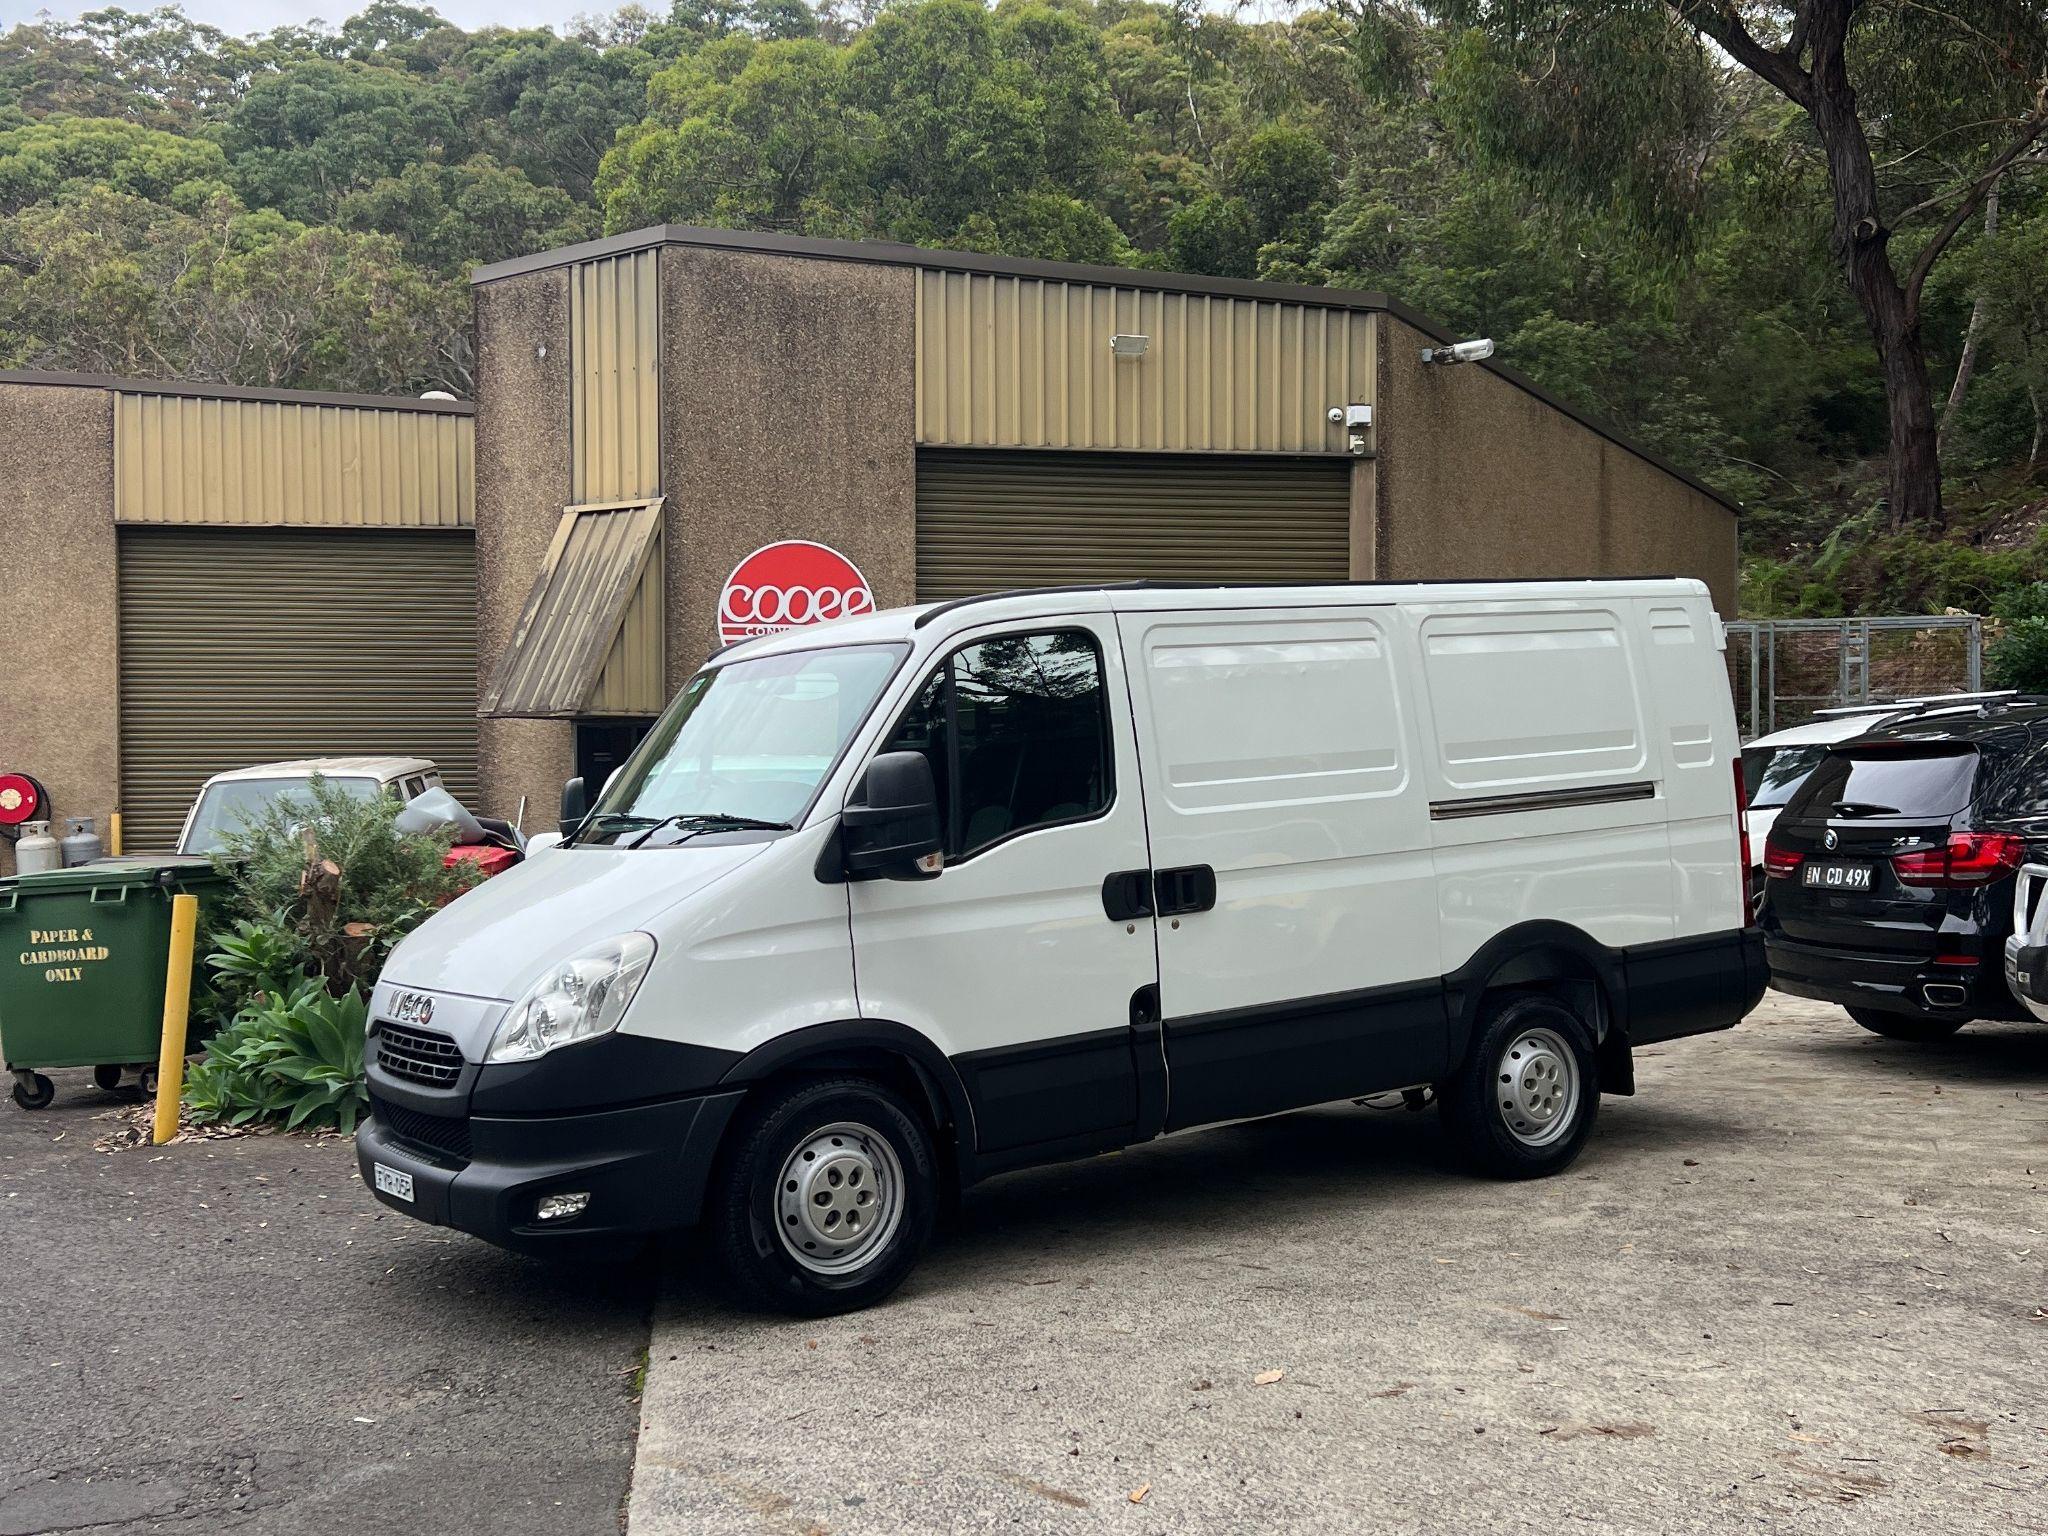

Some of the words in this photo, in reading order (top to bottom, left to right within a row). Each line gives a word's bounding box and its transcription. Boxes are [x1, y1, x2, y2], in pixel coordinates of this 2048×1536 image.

[1891, 836, 1920, 847] X5
[1845, 868, 1871, 886] 49X
[30, 929, 79, 944] PAPER
[82, 928, 94, 941] &
[20, 946, 109, 965] CARDBOARD
[45, 967, 83, 982] ONLY
[387, 990, 436, 1025] IVECO
